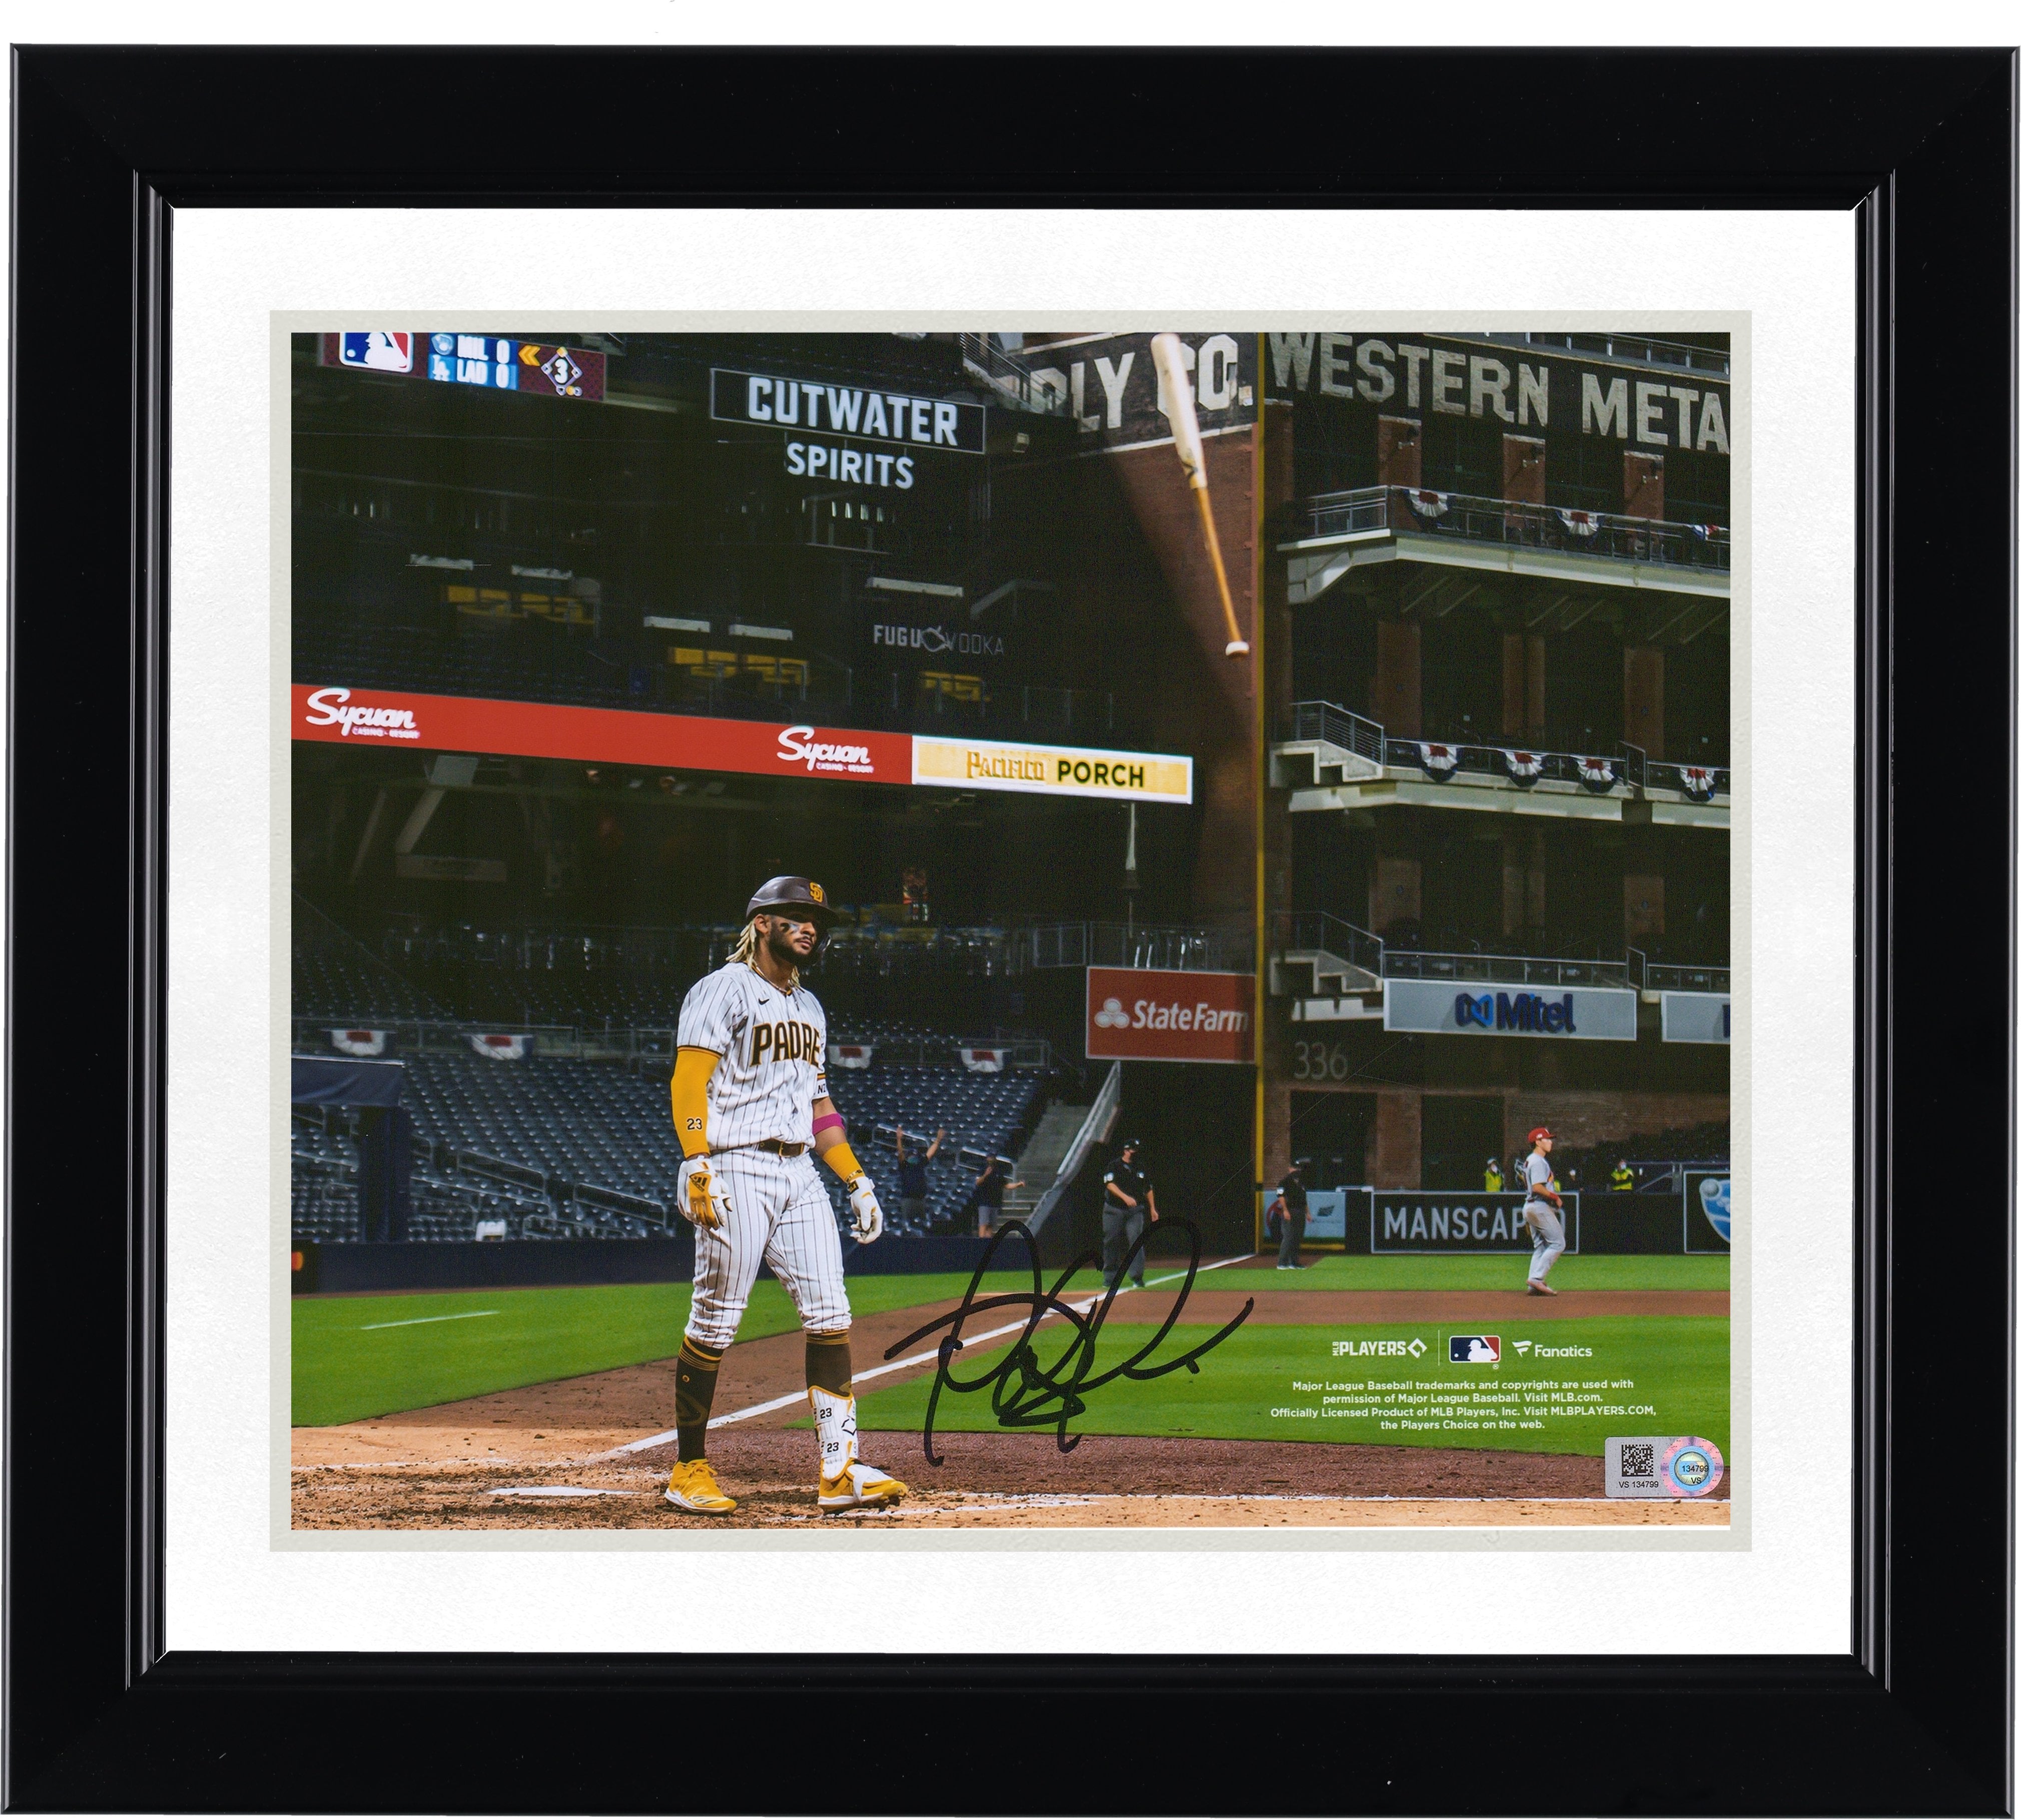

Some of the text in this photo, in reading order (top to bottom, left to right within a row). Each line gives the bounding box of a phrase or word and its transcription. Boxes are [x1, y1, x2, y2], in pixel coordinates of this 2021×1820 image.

[457, 359, 488, 384] LAD
[554, 358, 569, 384] 3
[1269, 332, 1730, 454] WESTERN META
[749, 376, 958, 446] CUTWATER
[787, 442, 915, 489] SPIRITS
[874, 625, 1003, 655] FUGU VODKA
[306, 687, 417, 737] Sycuan
[777, 725, 871, 771] Sycuan
[1058, 760, 1144, 788] PORCH
[1496, 992, 1576, 1033] Mitel
[1294, 1041, 1349, 1080] 336
[687, 1117, 703, 1130] 23
[1384, 1206, 1566, 1240] MANSCAP
[820, 1407, 832, 1419] 23
[827, 1442, 839, 1453] 23
